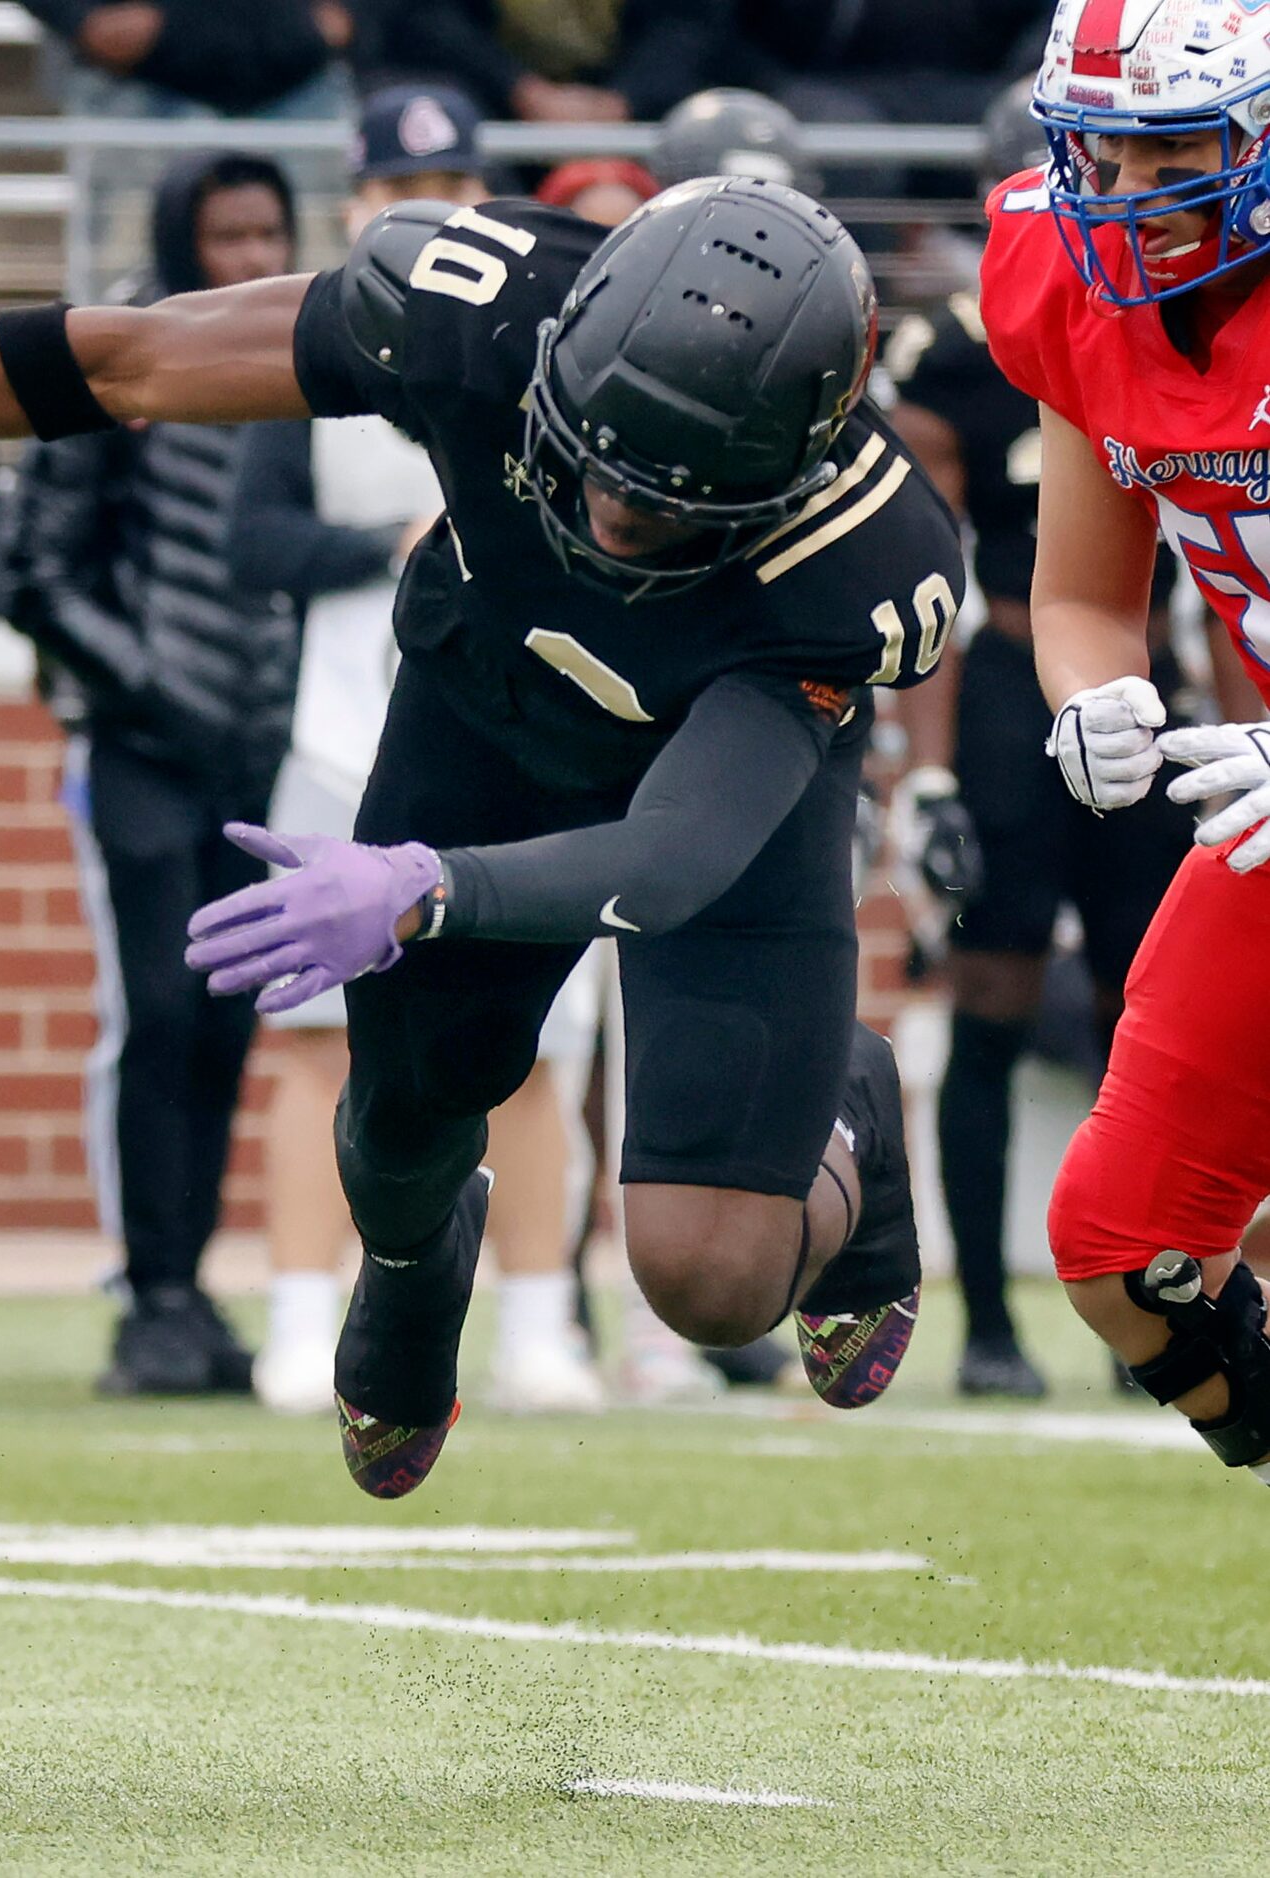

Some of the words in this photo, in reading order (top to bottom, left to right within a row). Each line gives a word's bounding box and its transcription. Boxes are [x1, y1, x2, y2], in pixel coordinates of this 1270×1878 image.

[1193, 30, 1210, 39] ARE
[1233, 57, 1246, 67] WE
[1128, 66, 1155, 80] FIGHT
[1198, 71, 1223, 88] GUYS
[1229, 68, 1246, 78] ARE
[1132, 82, 1160, 95] FIGHT
[408, 207, 537, 306] 10
[1103, 436, 1270, 504] Heritag
[865, 571, 958, 685] 10
